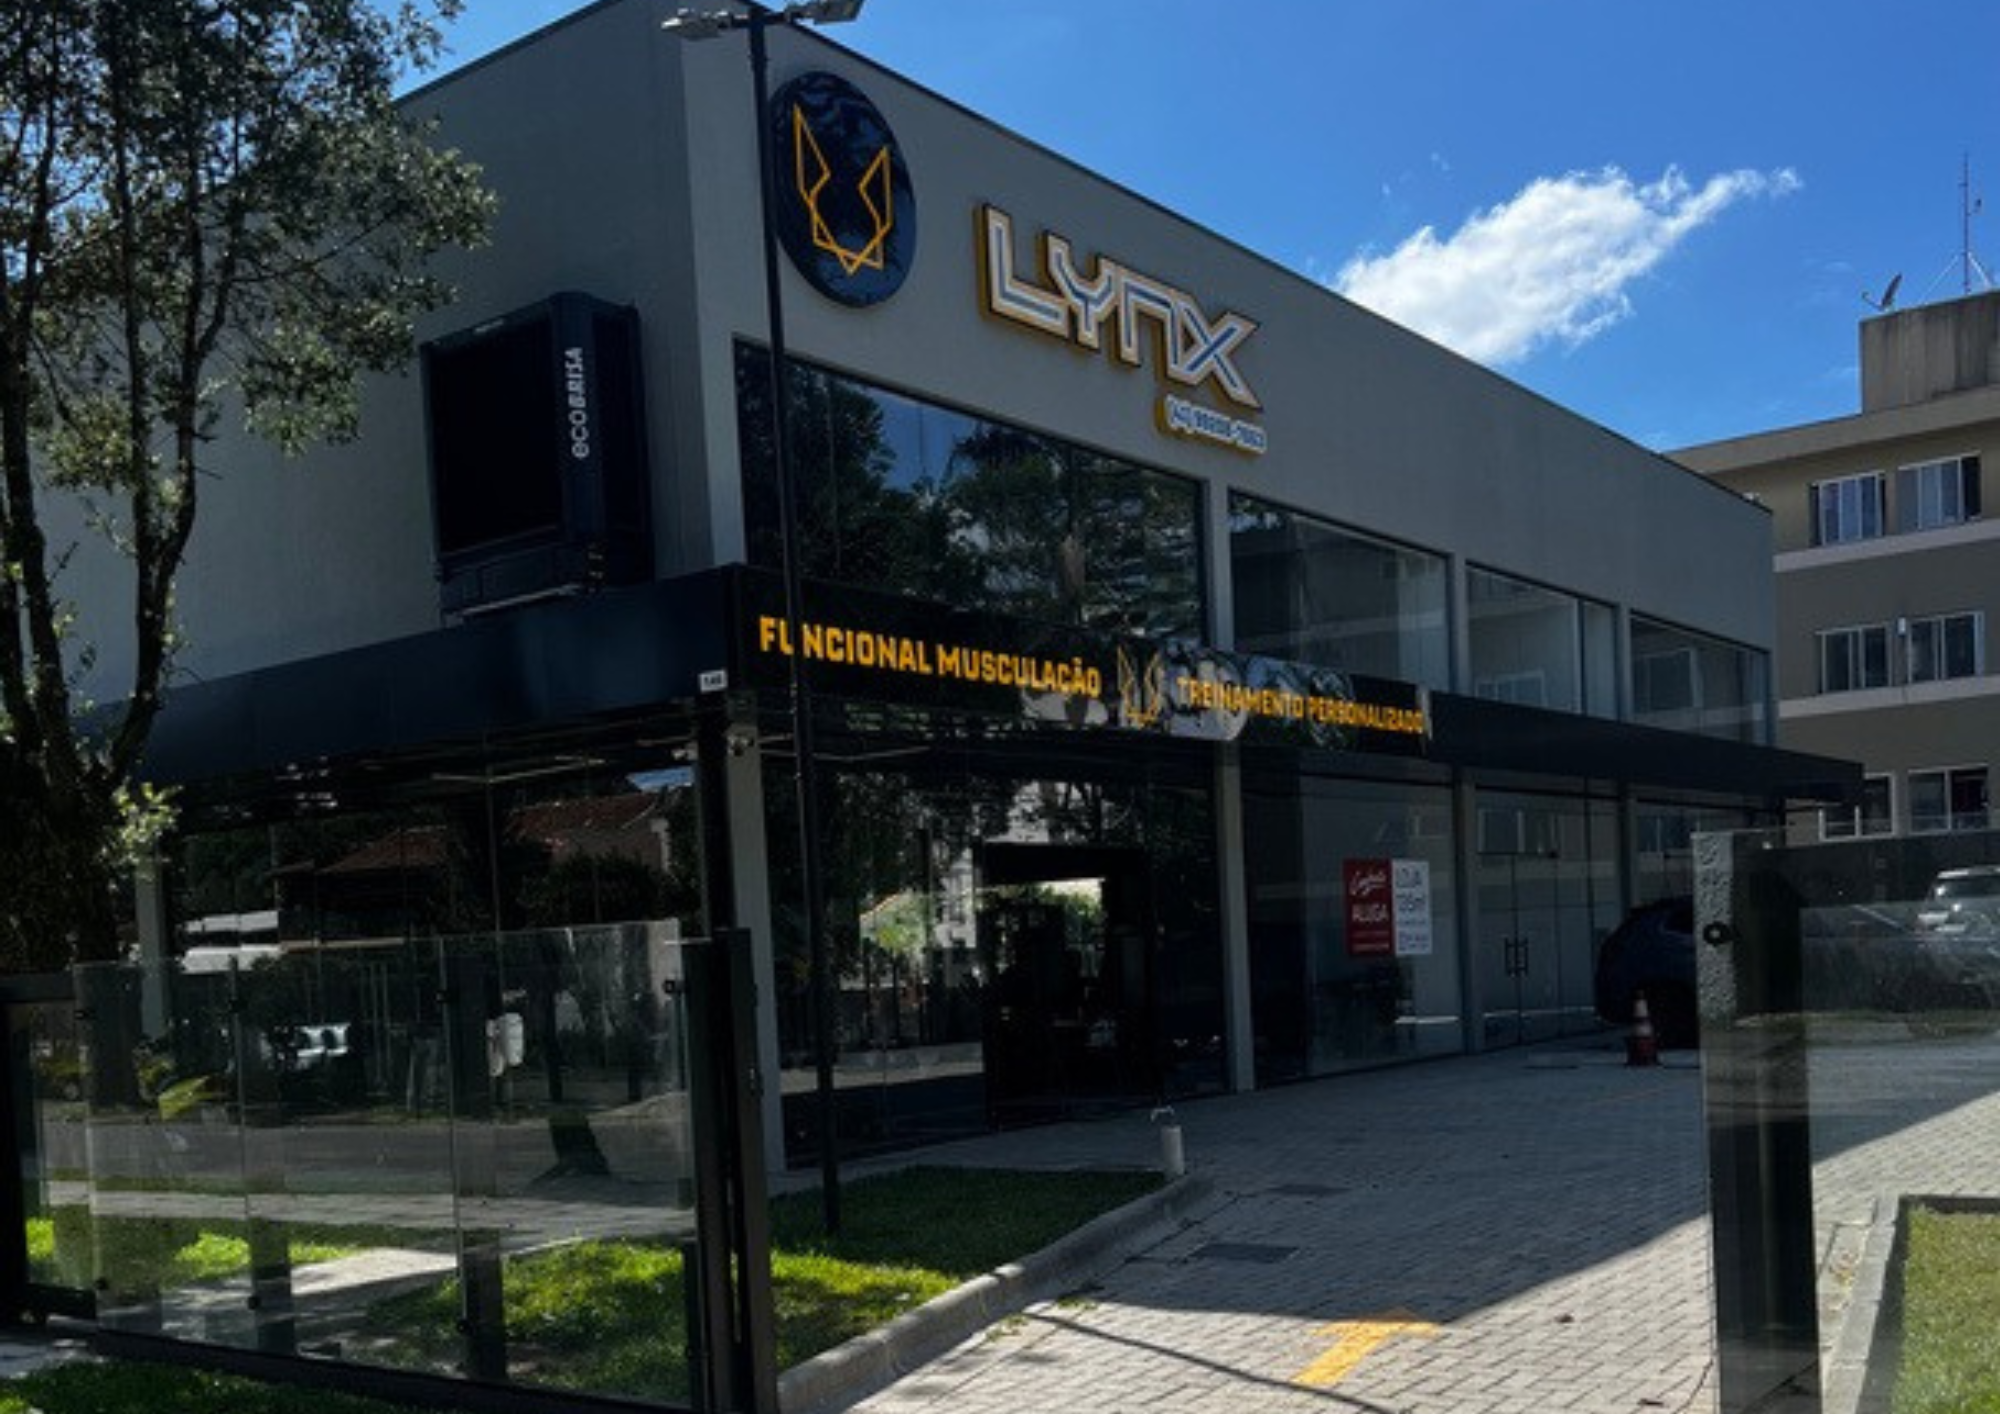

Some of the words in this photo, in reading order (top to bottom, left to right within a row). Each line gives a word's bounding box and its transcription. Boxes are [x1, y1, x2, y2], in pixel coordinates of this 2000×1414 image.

[979, 203, 1261, 409] LYNX
[759, 615, 932, 674] FUNCIONAL
[937, 643, 1101, 699] MUSCULAÇÃO
[1176, 677, 1303, 718] TREINAMENTO
[1308, 695, 1424, 735] PERSONALIZADO
